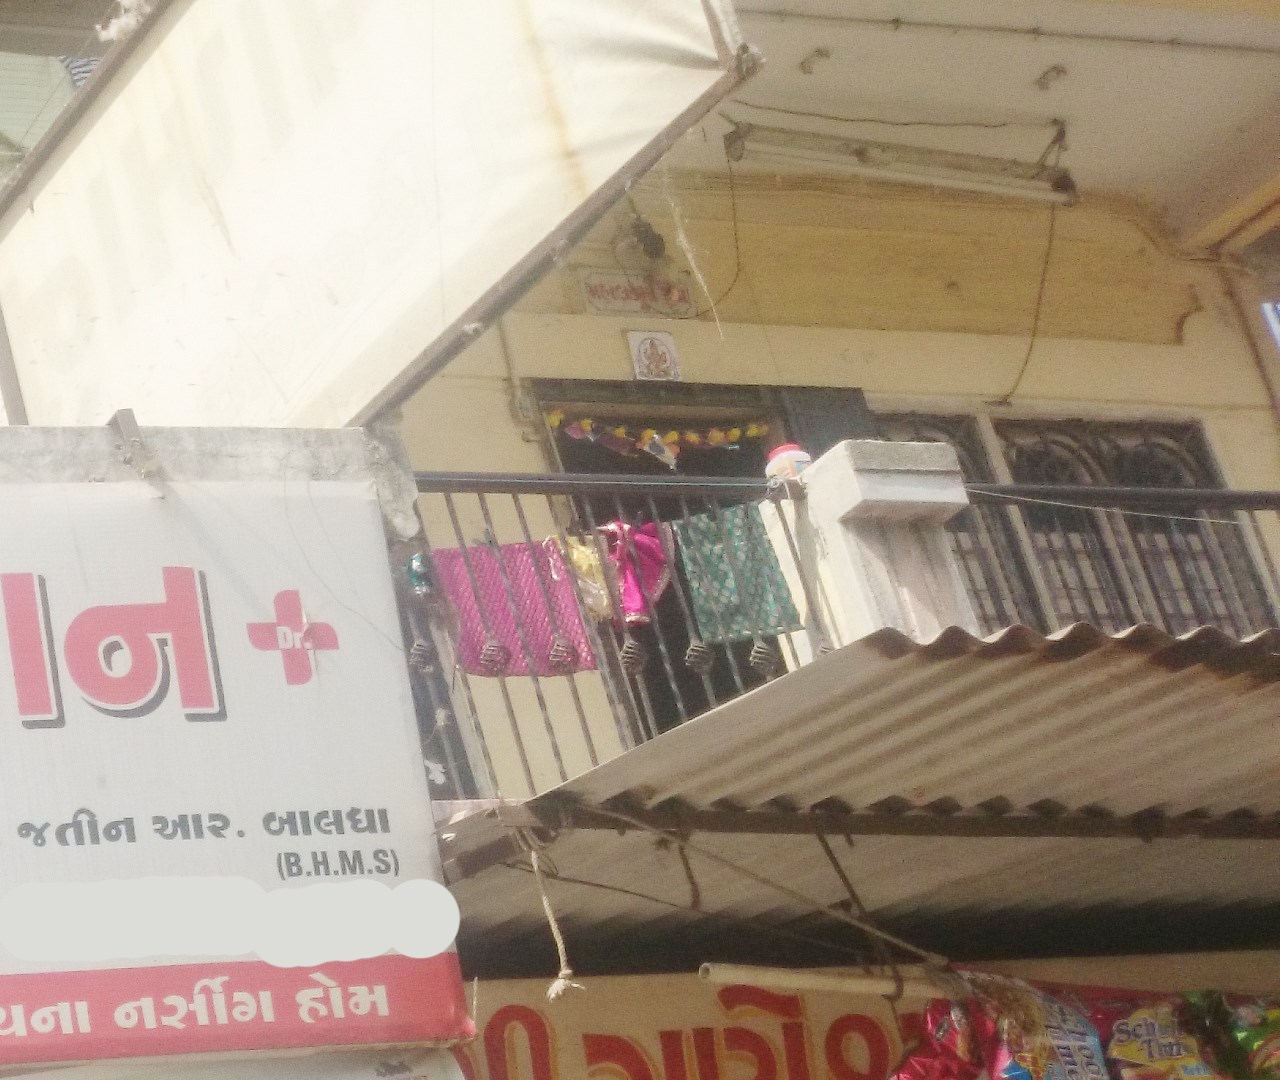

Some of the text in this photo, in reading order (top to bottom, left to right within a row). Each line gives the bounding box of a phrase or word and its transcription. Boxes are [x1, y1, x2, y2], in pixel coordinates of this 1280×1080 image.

[17, 808, 136, 848] જતીન
[152, 812, 245, 841] આર.
[277, 849, 400, 881] (B.H.M.S)
[295, 973, 390, 1024] હોમ
